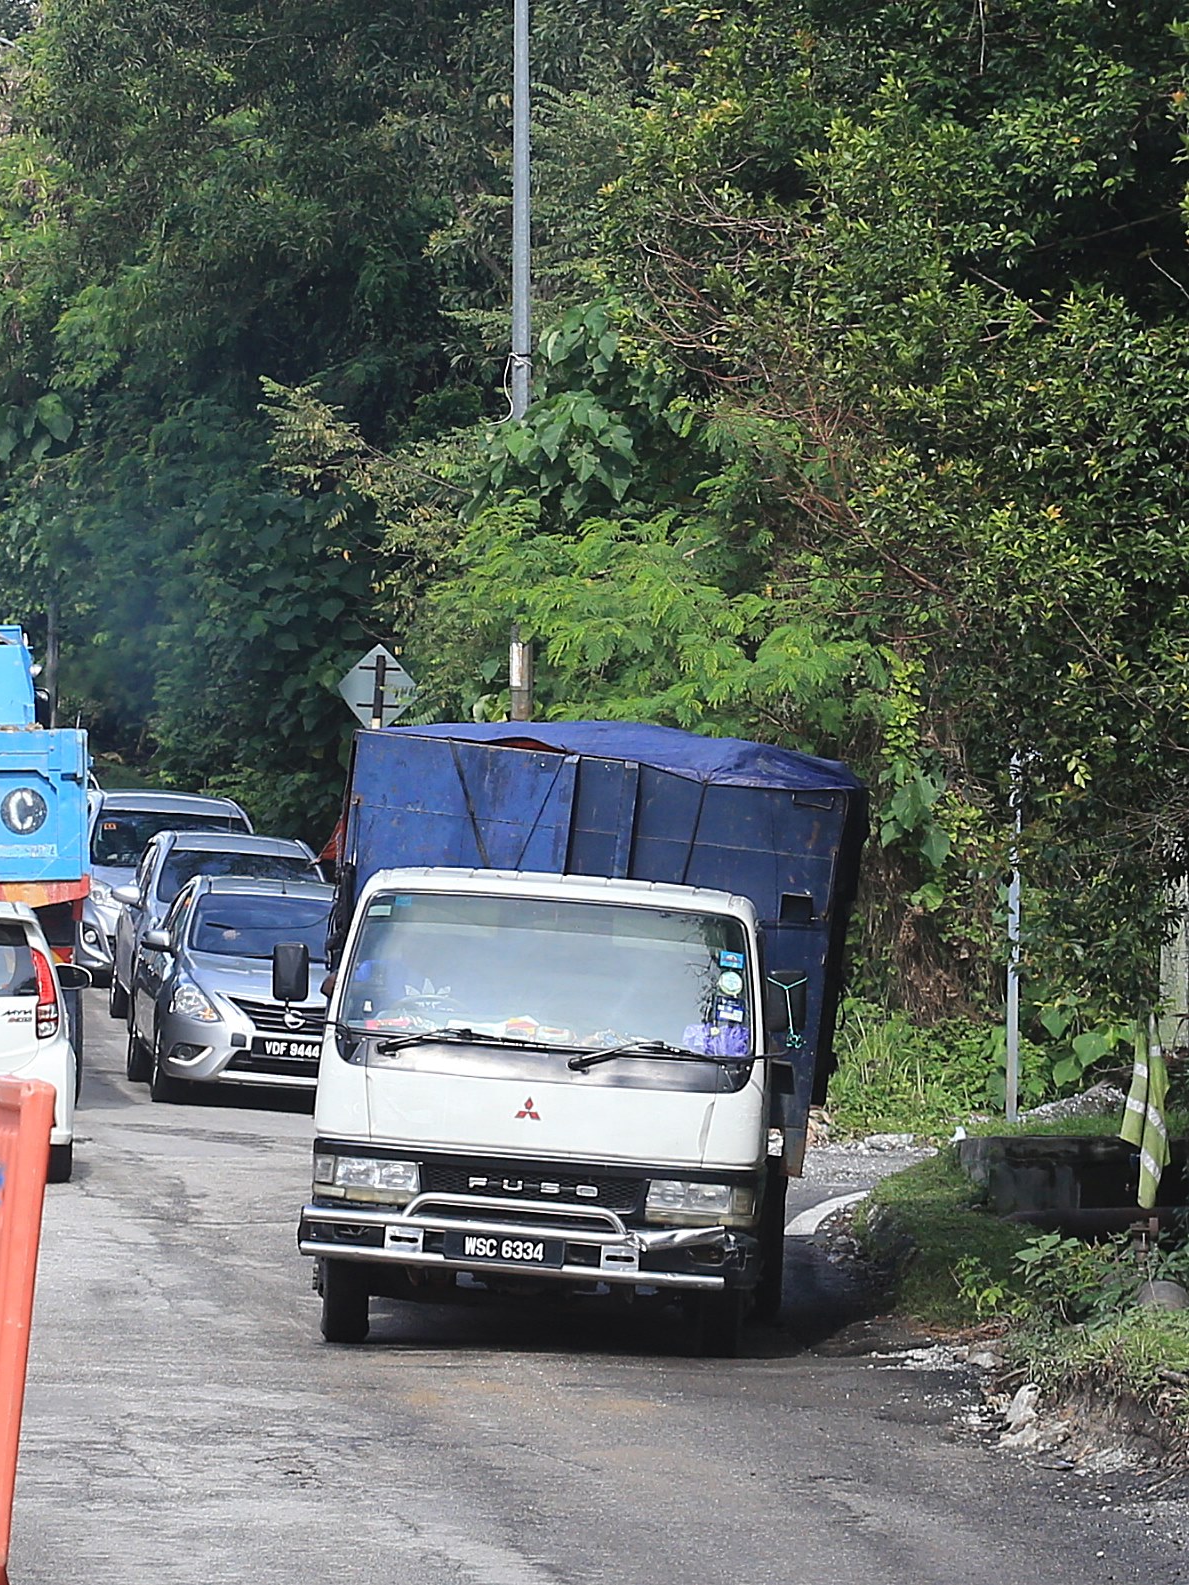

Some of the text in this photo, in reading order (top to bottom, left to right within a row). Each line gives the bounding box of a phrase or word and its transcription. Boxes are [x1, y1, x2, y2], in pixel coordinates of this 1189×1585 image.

[9, 791, 33, 830] C
[265, 1040, 320, 1058] VDF 9444
[468, 1176, 599, 1198] FUSO
[464, 1235, 545, 1262] WSC 6334
